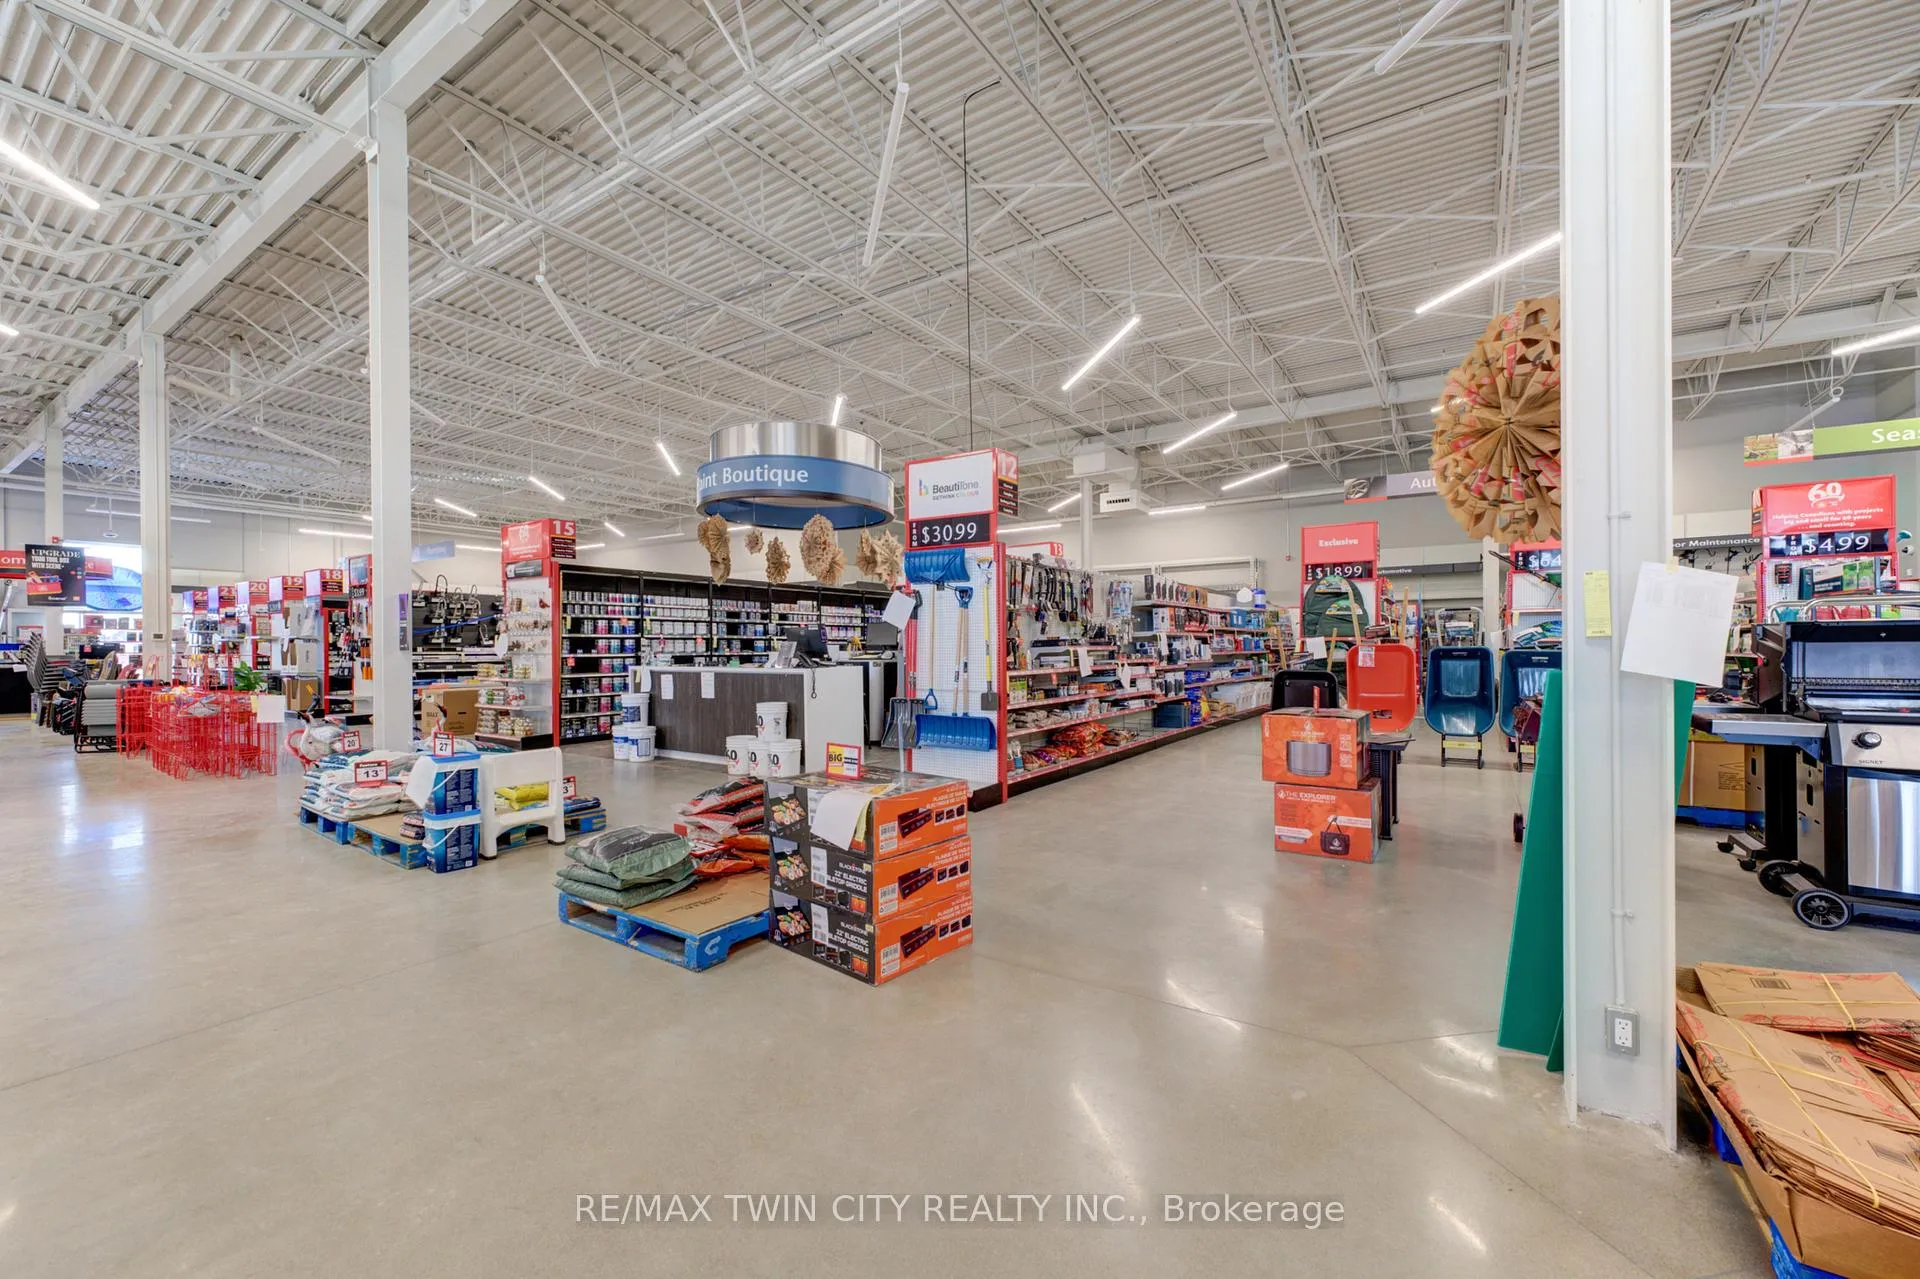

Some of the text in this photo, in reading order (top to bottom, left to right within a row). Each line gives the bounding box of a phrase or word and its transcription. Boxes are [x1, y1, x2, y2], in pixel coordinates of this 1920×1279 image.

[1872, 428, 1920, 443] Sea
[1000, 453, 1017, 480] 12
[722, 464, 809, 487] Boutique
[1808, 482, 1844, 502] 60
[553, 520, 575, 536] 15
[1318, 536, 1359, 547] Exclusive
[1688, 537, 1760, 547] Maintenance
[31, 548, 81, 559] UPGRADE
[1054, 543, 1063, 556] 13
[286, 576, 303, 586] 19
[323, 569, 343, 580] 18
[251, 582, 267, 592] 20
[439, 742, 449, 752] 27
[828, 753, 843, 762] BIG
[842, 871, 868, 885] ELECTRIC
[845, 880, 868, 893] GRIDDLE
[844, 930, 869, 946] ELECTRIC
[847, 939, 869, 954] GRIDDLE
